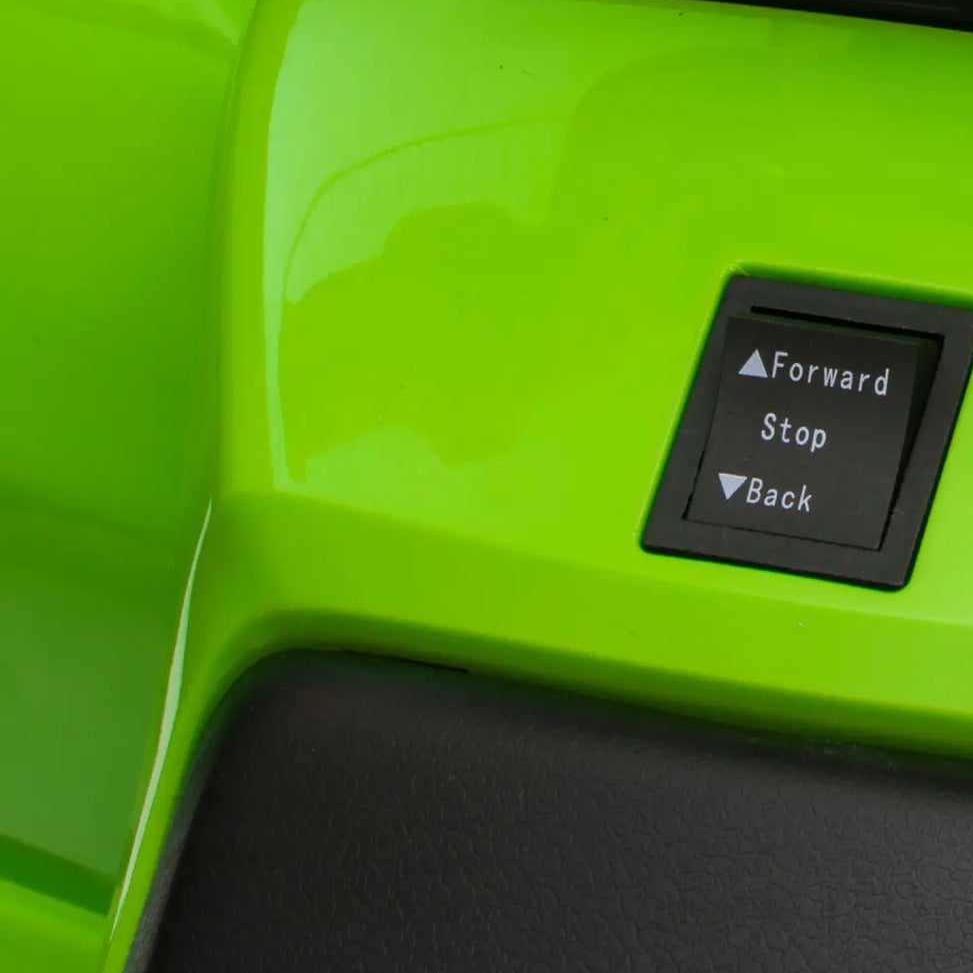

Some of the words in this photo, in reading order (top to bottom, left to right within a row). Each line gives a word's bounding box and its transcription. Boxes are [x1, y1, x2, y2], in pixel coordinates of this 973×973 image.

[772, 351, 889, 396] Forward
[761, 412, 828, 452] Stop
[746, 477, 813, 512] Back
